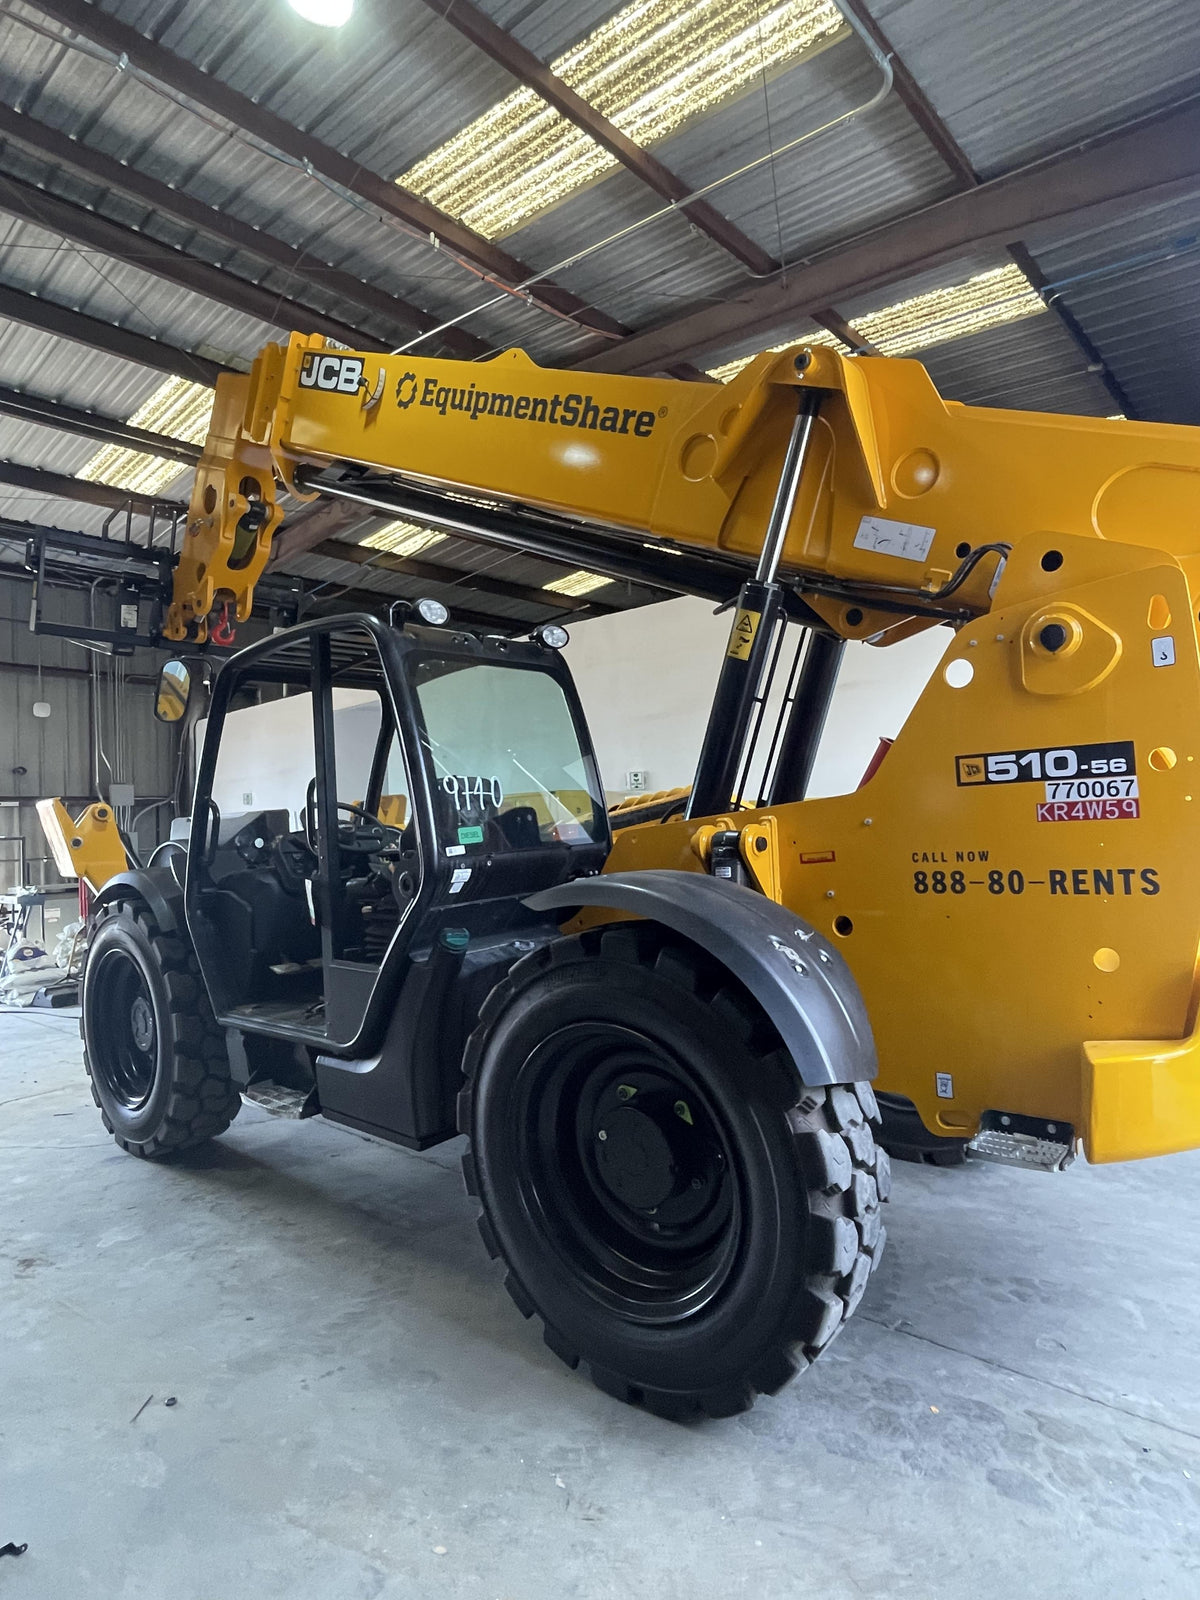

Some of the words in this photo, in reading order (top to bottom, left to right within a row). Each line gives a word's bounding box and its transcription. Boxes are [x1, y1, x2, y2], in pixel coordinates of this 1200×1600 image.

[300, 356, 363, 393] JCB
[420, 378, 656, 437] EquipmentShare
[987, 750, 1127, 782] 510-56
[444, 775, 503, 811] 9740
[1047, 779, 1135, 799] 770067
[1037, 800, 1138, 821] KR4W59
[912, 852, 948, 863] CALL
[956, 851, 990, 862] NOW
[913, 868, 1161, 895] 888-80-RENTS
